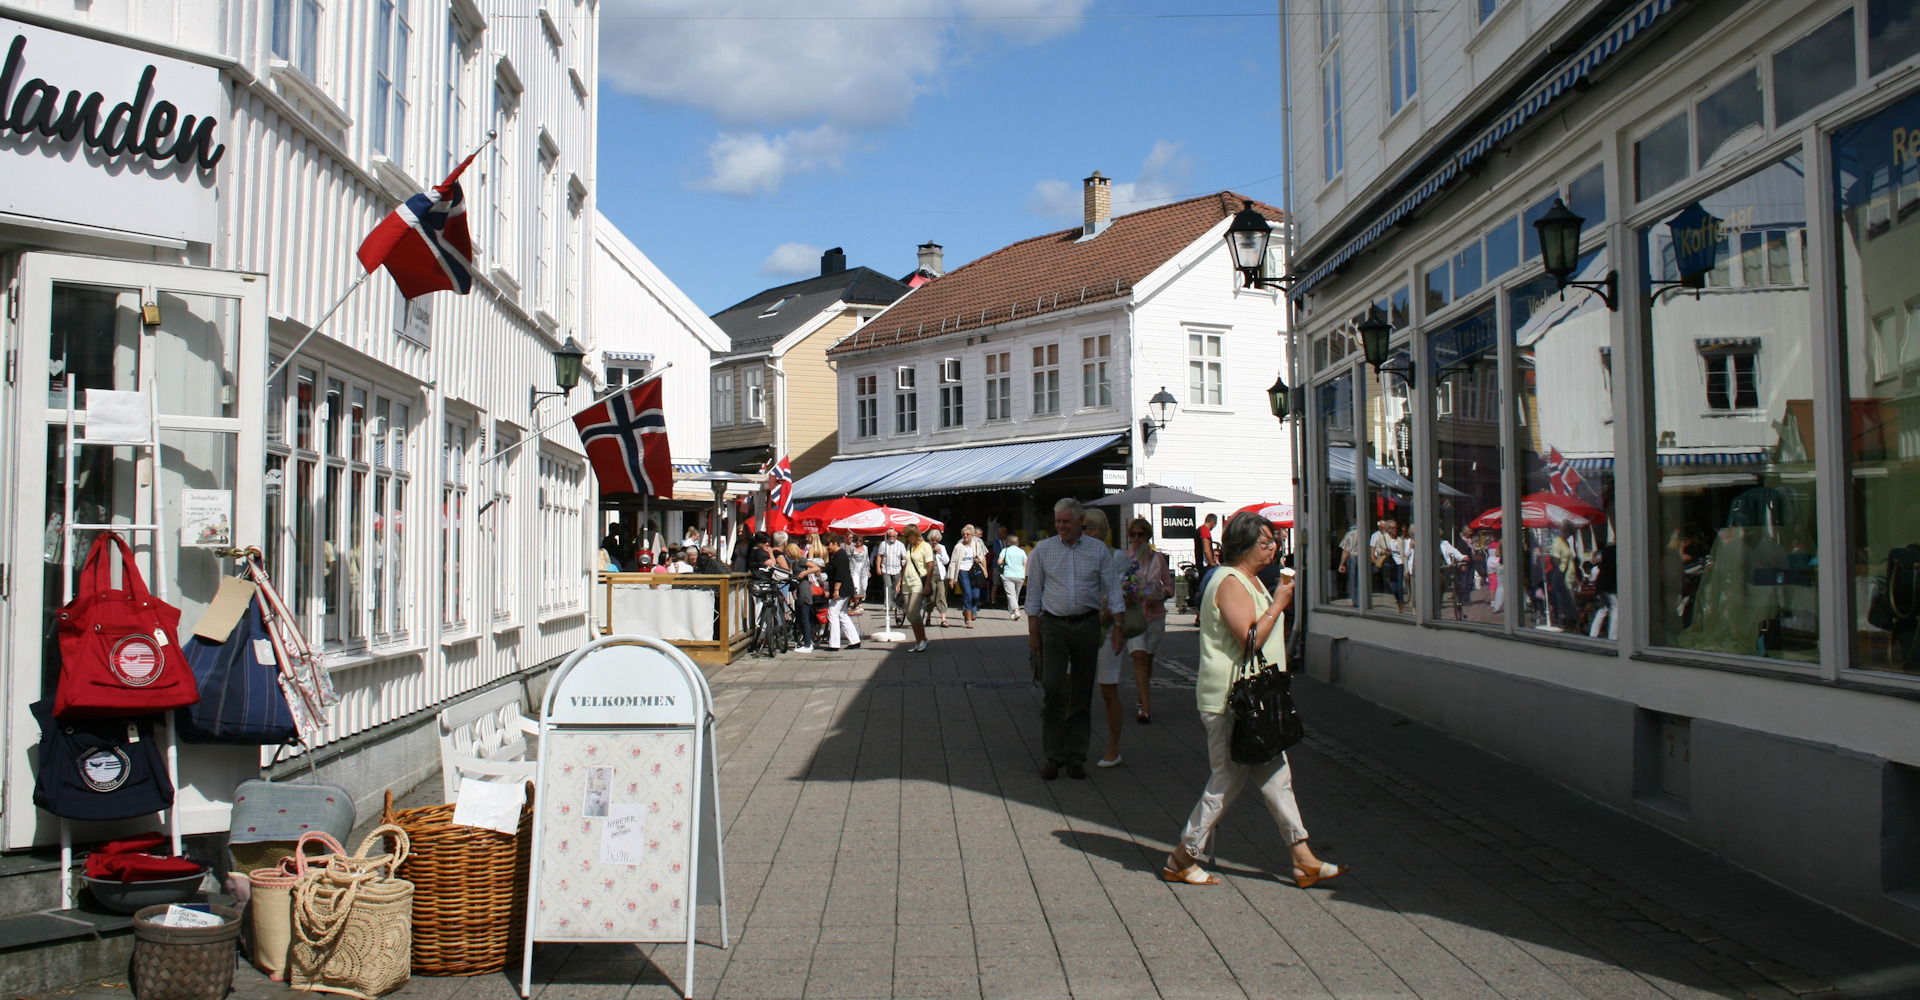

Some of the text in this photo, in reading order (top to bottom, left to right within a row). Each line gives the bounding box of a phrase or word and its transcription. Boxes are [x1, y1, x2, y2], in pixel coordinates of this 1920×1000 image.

[1681, 205, 1755, 257] Kofferter
[1163, 518, 1195, 527] BIANCA
[570, 696, 677, 707] VELKOMMEN
[607, 815, 638, 829] NYHETER
